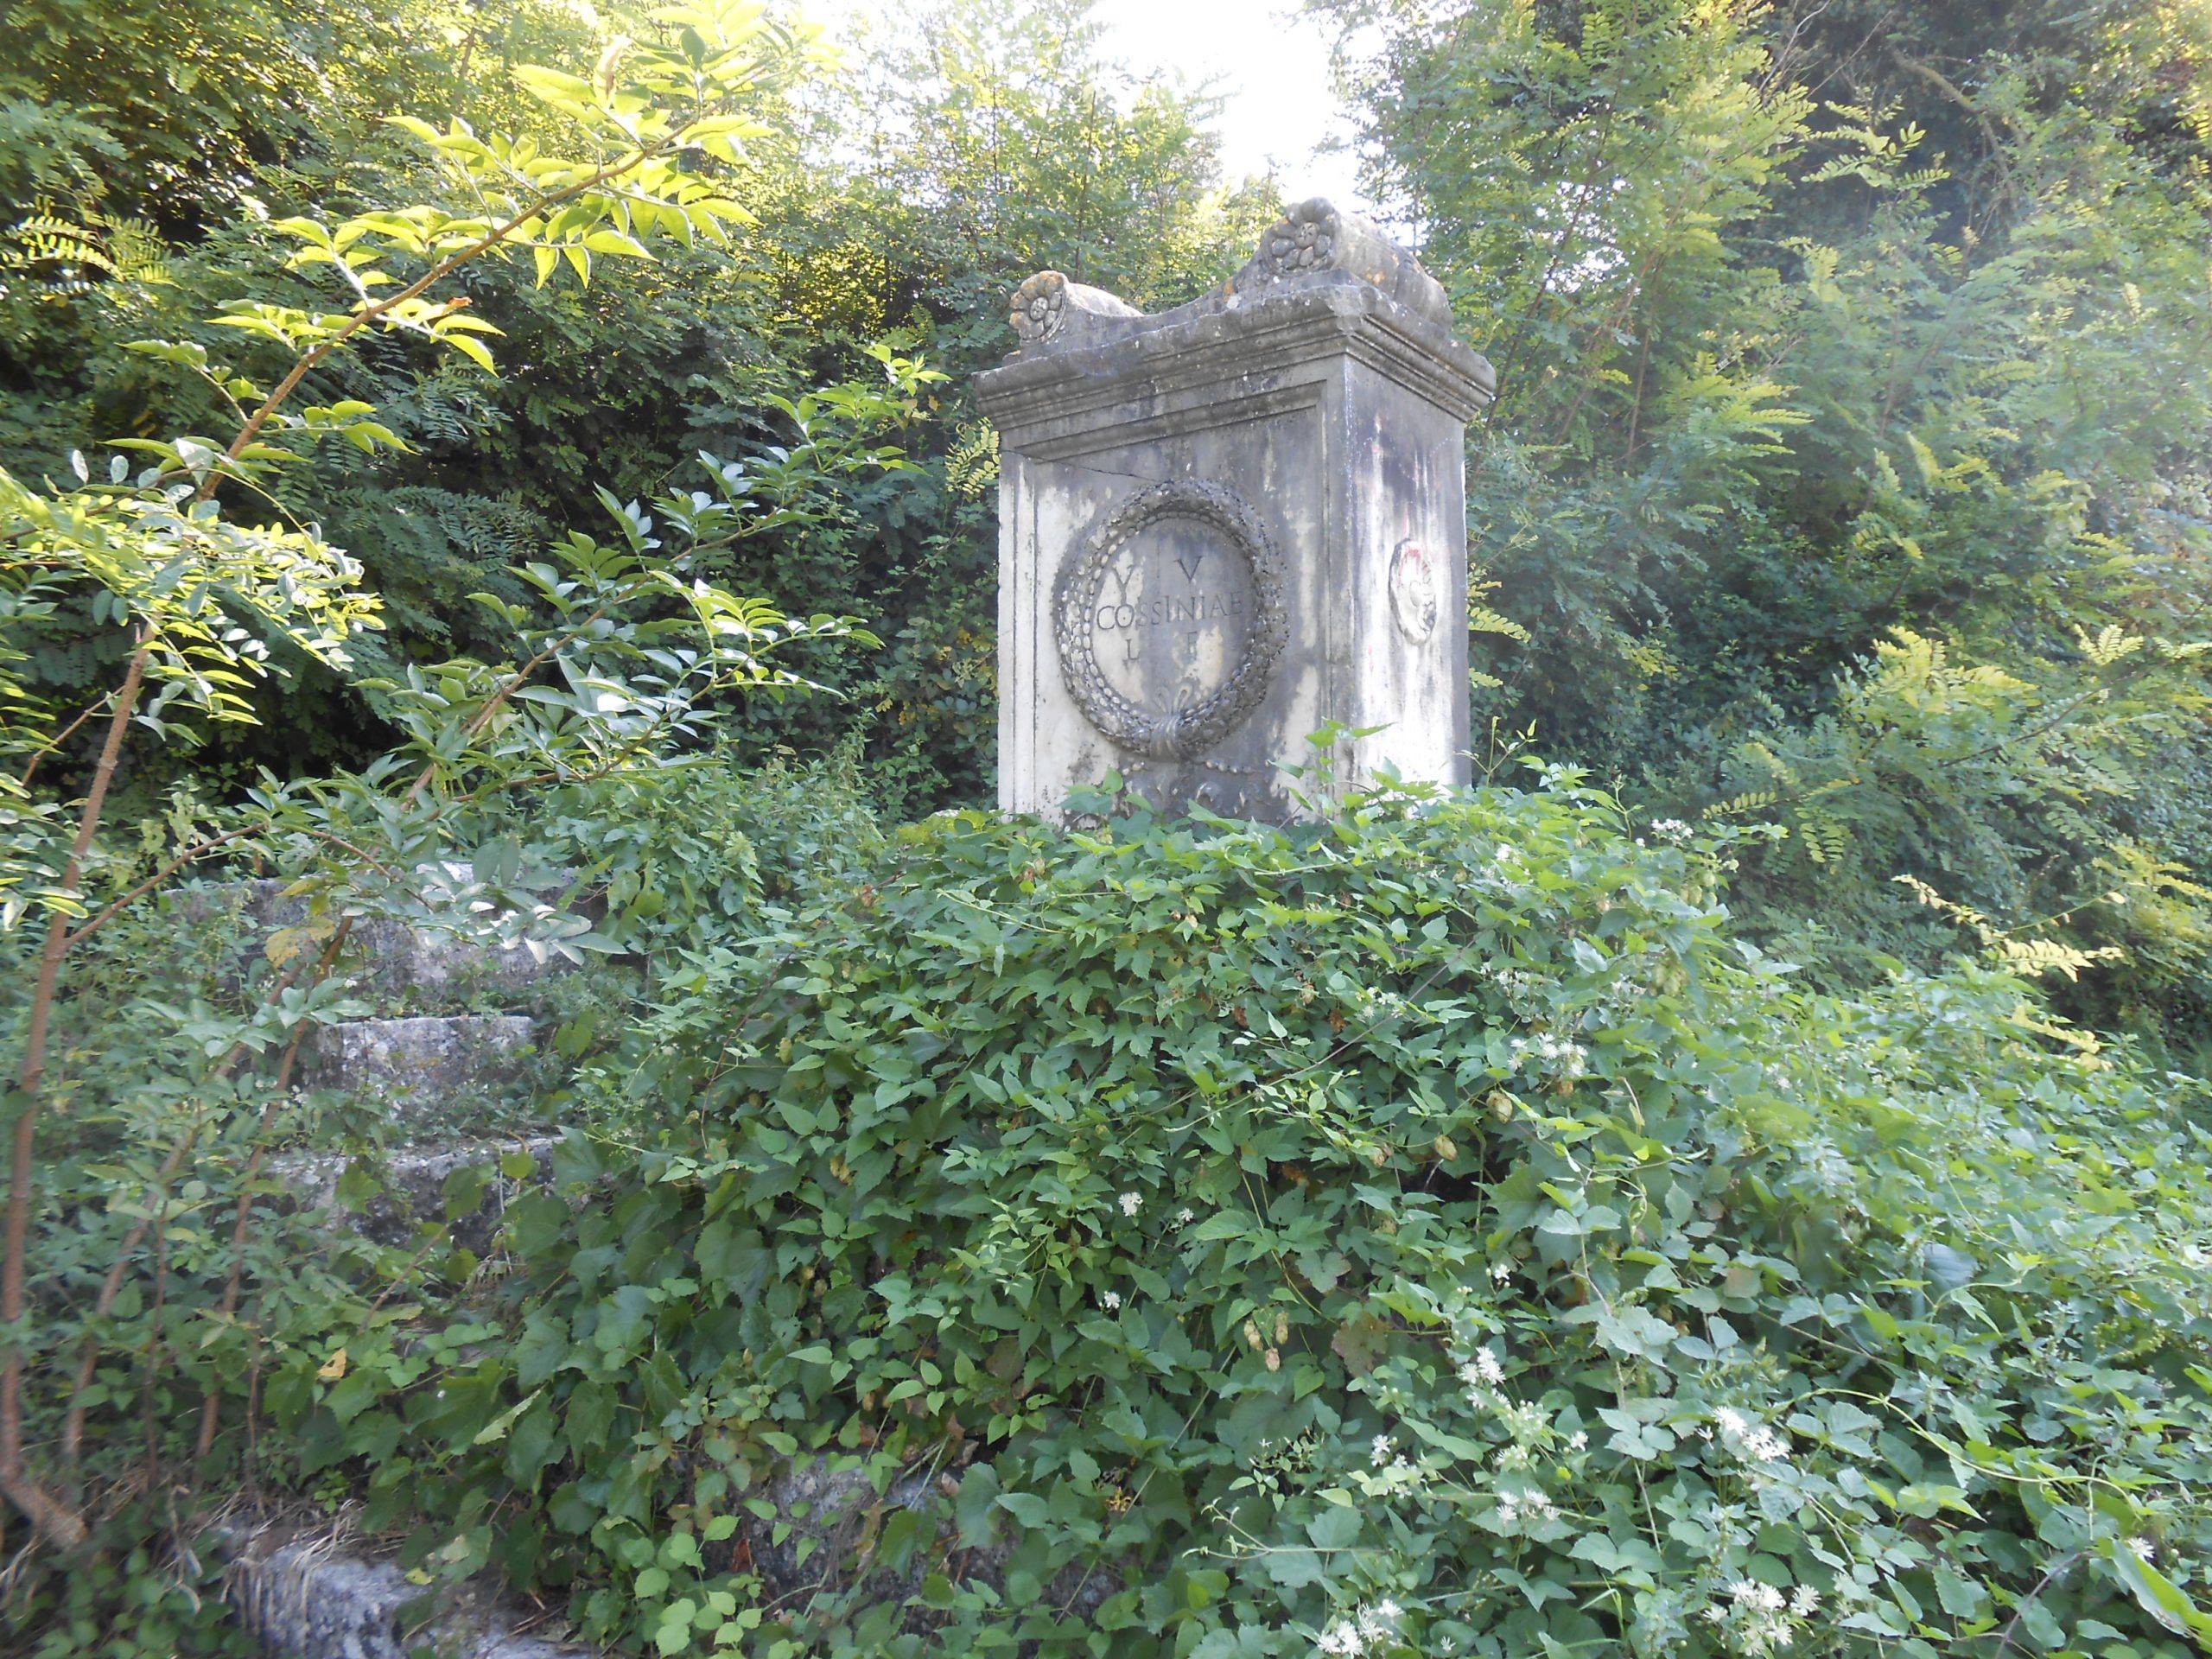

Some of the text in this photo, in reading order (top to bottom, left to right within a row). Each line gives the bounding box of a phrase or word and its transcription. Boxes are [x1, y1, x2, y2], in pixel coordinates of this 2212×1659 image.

[1173, 555, 1204, 582] V
[1096, 591, 1243, 630] COSSINIAE
[1124, 638, 1141, 661] L
